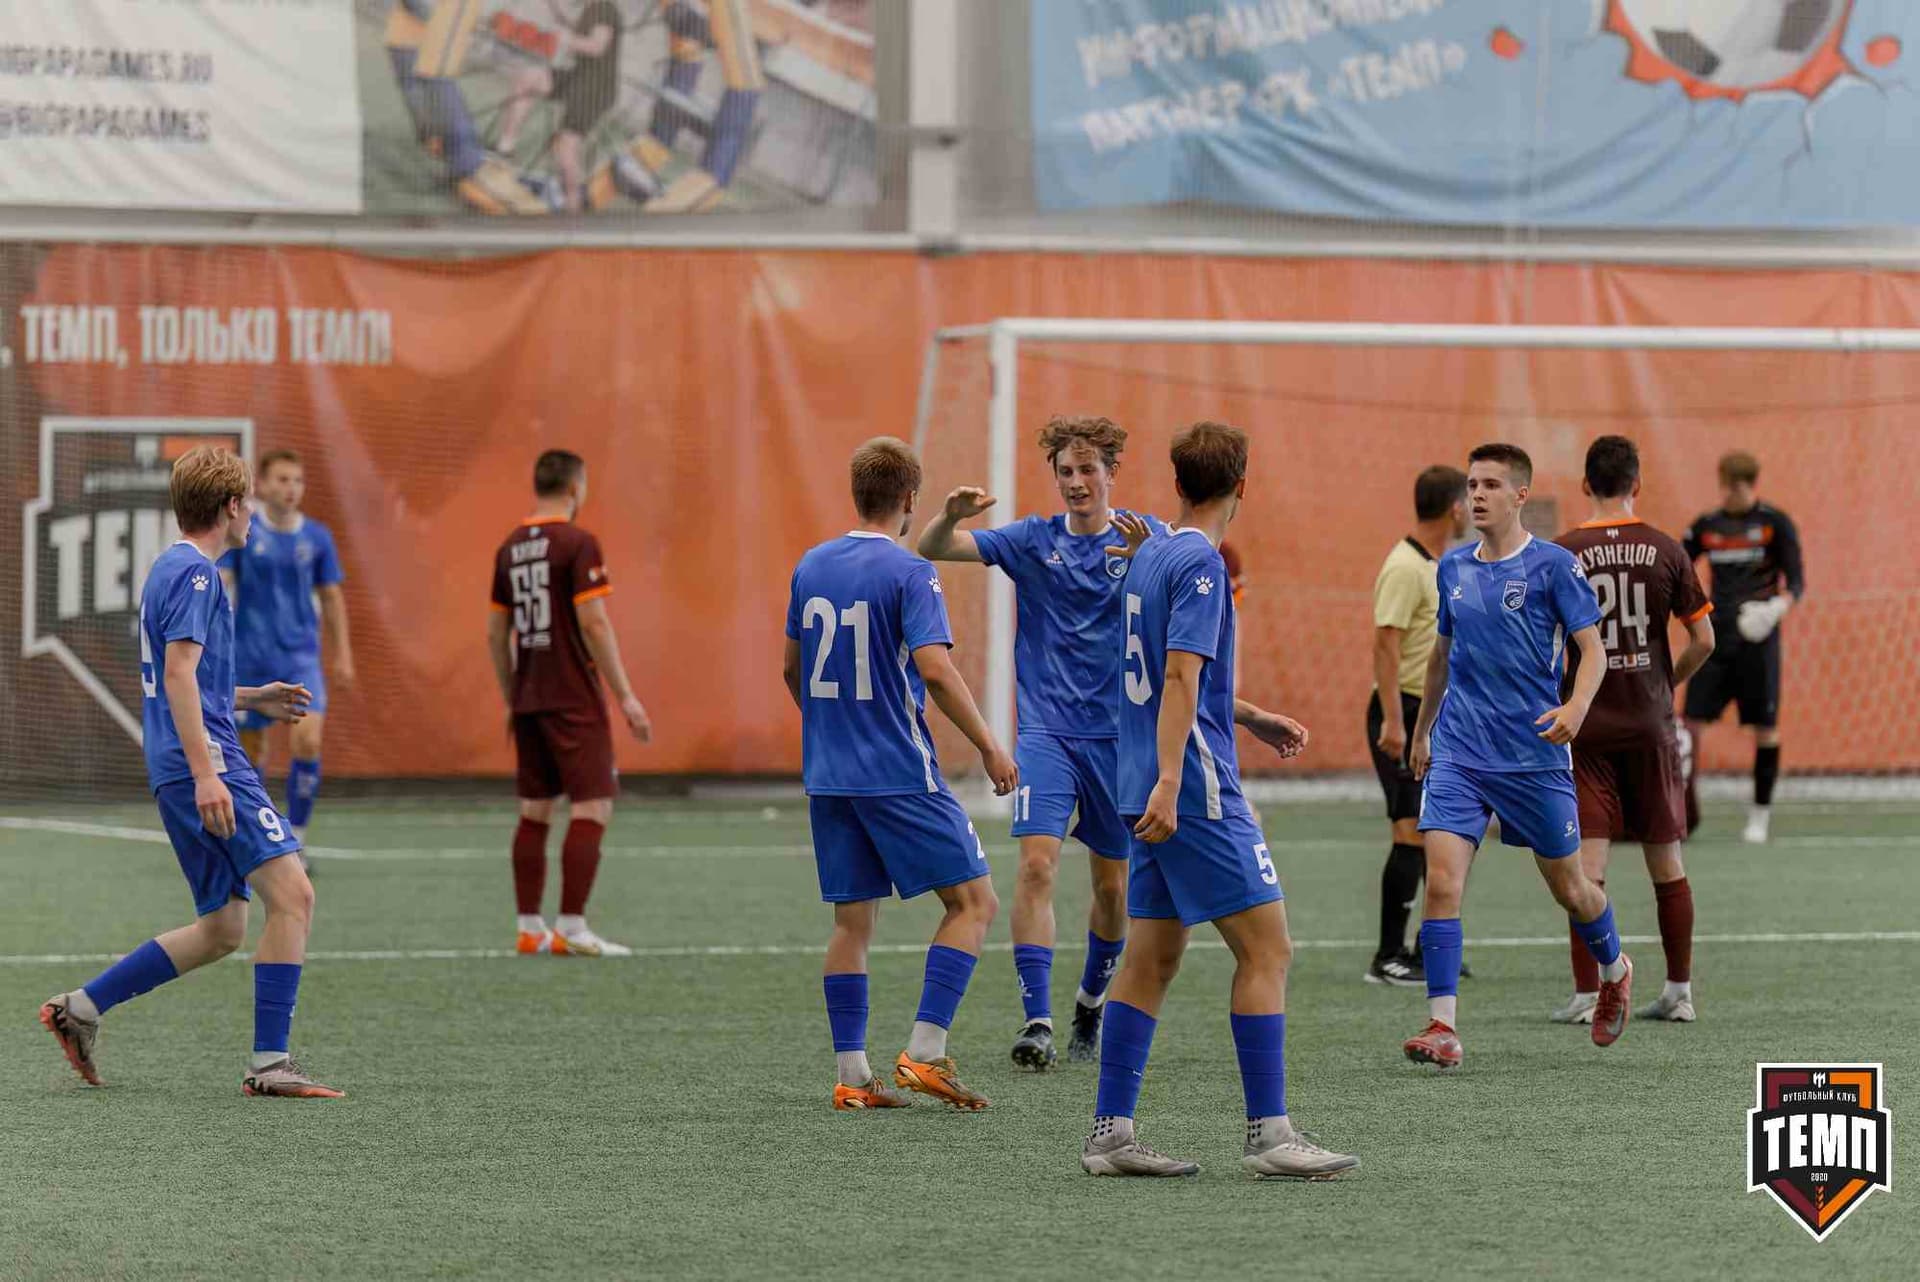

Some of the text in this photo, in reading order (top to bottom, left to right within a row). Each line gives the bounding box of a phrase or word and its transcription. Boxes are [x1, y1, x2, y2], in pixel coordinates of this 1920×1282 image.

[20, 304, 129, 369] ТЕМП,
[138, 305, 278, 366] ТОЛЬКО
[509, 560, 551, 633] 55
[1587, 571, 1650, 650] 24
[802, 596, 873, 701] 21
[1124, 592, 1153, 706] 5
[1607, 651, 1651, 670] EUS
[257, 806, 285, 843] 9
[1252, 842, 1278, 885] 5
